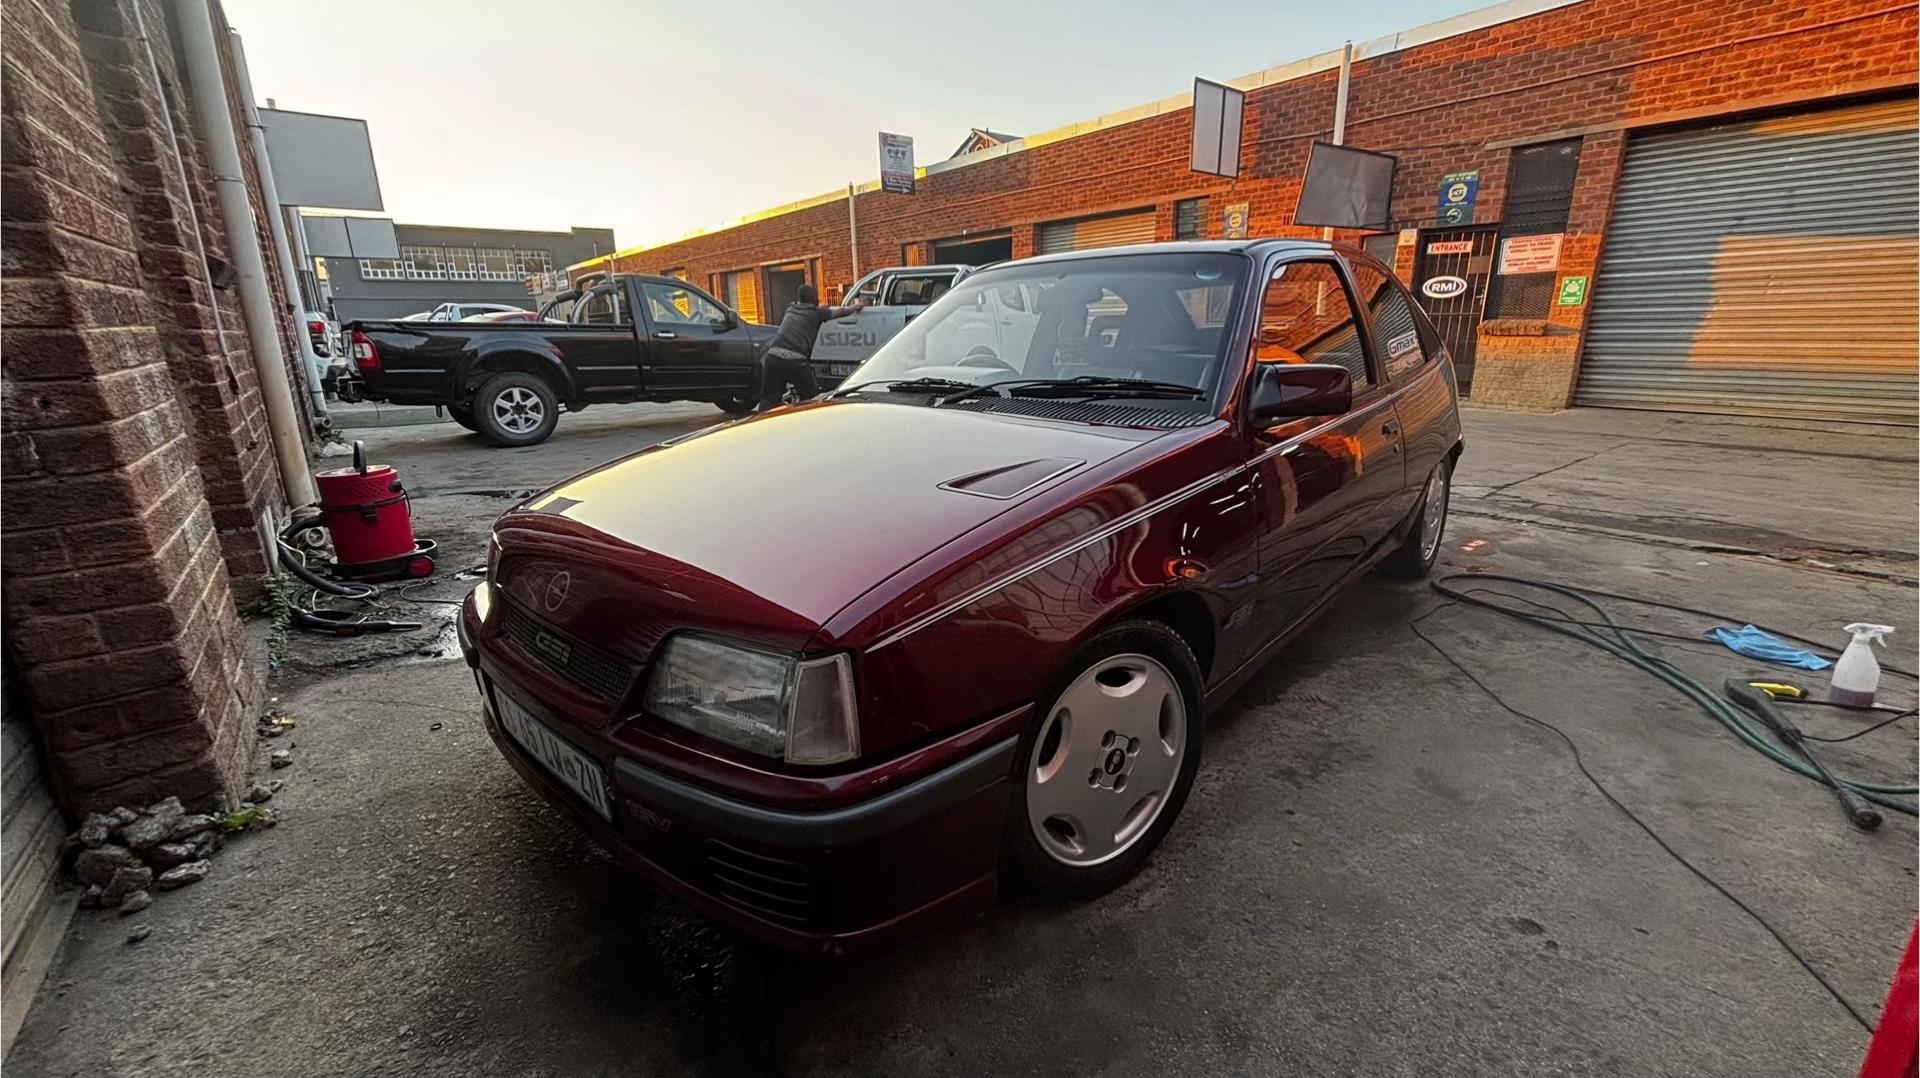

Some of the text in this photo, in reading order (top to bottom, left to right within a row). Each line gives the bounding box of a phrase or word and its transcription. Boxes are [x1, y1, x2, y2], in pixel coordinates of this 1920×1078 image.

[1430, 242, 1468, 253] ENTRANCE
[1431, 280, 1457, 292] RMI
[820, 331, 876, 347] ISUZU
[573, 753, 604, 809] ZN
